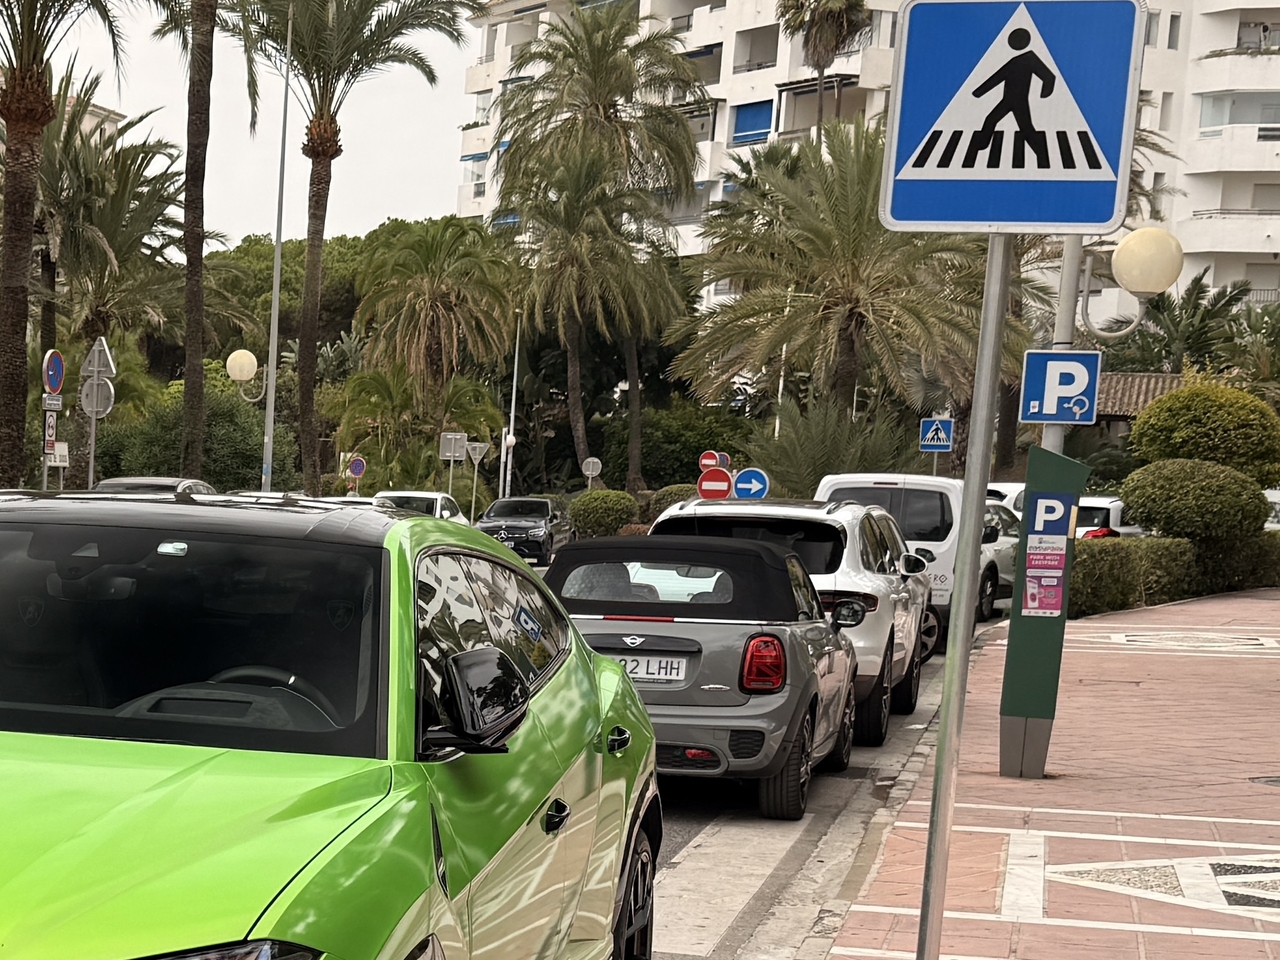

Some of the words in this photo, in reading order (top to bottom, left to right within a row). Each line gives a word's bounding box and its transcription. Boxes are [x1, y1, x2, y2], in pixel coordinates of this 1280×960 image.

[1042, 360, 1090, 415] P
[1034, 498, 1065, 531] P
[646, 659, 680, 676] LHH
